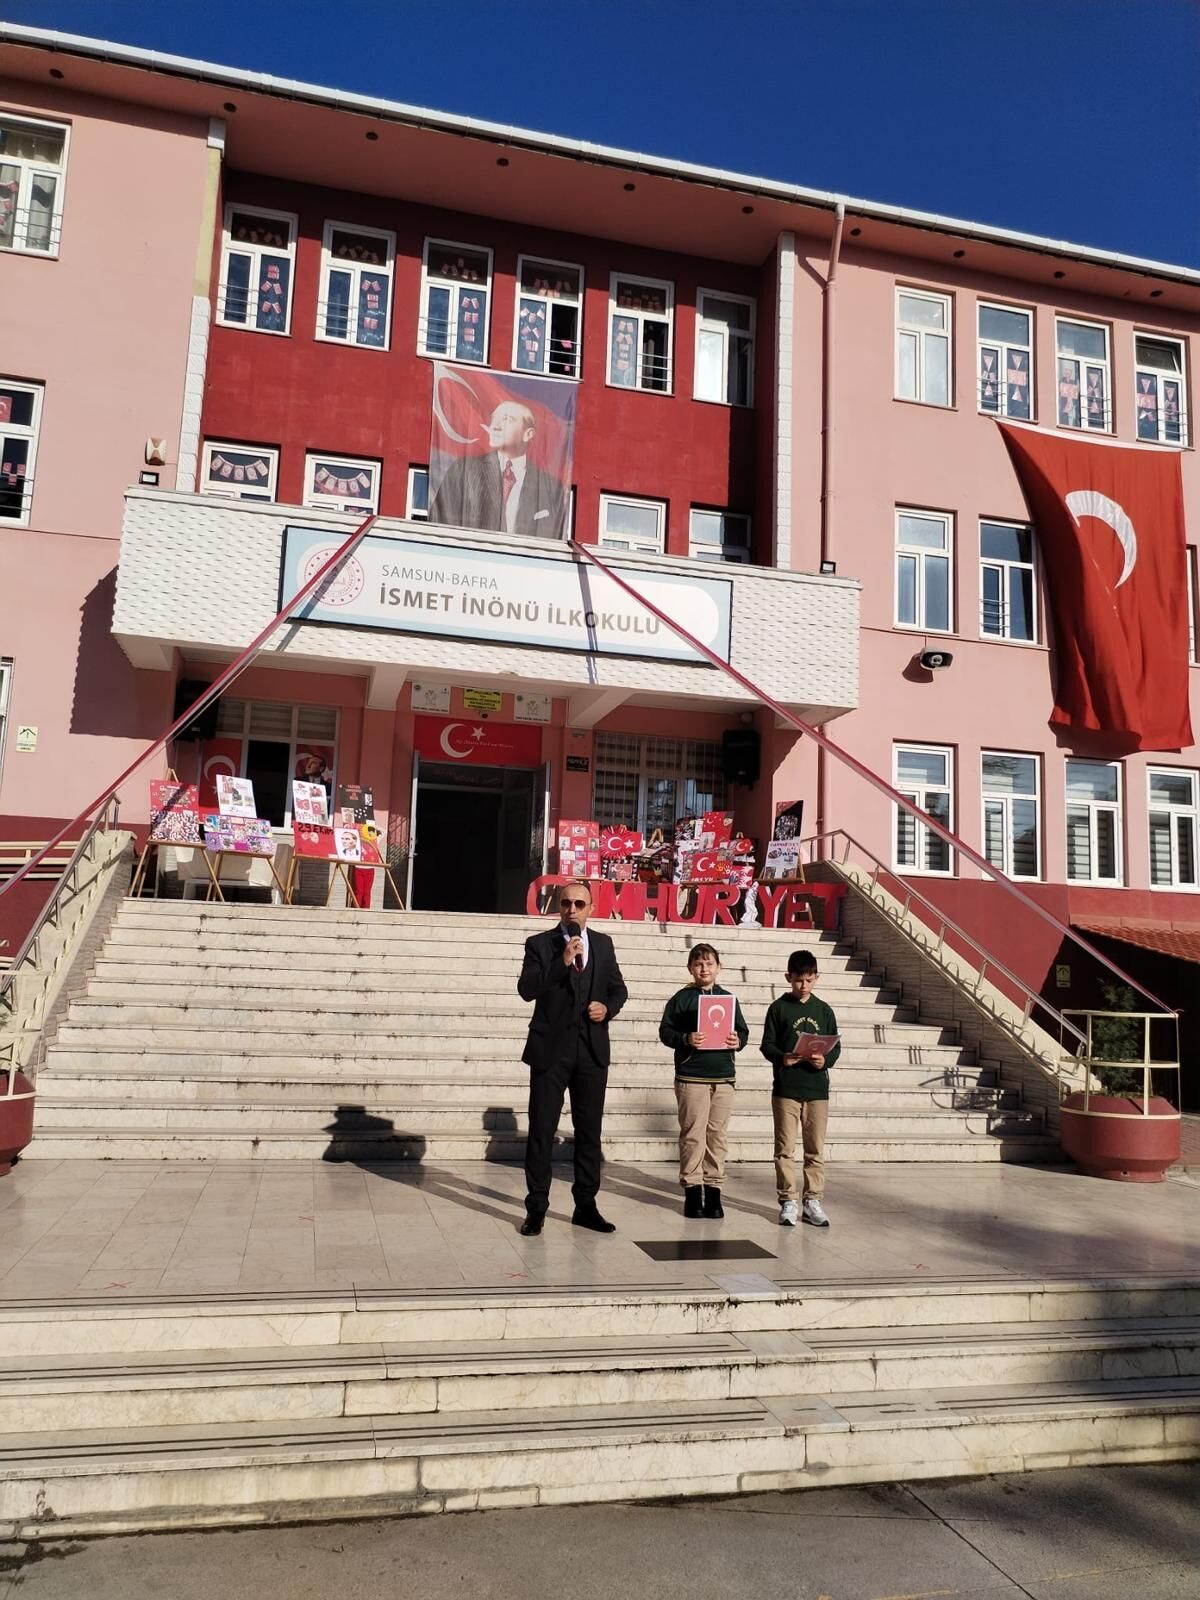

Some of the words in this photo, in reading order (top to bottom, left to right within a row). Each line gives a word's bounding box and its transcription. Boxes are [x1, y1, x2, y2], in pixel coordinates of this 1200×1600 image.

[381, 564, 498, 590] SAMSUN-BAFRA
[379, 582, 454, 612] İSMET
[461, 592, 540, 623] İNÖNÜ
[547, 602, 660, 635] İLKOKULU
